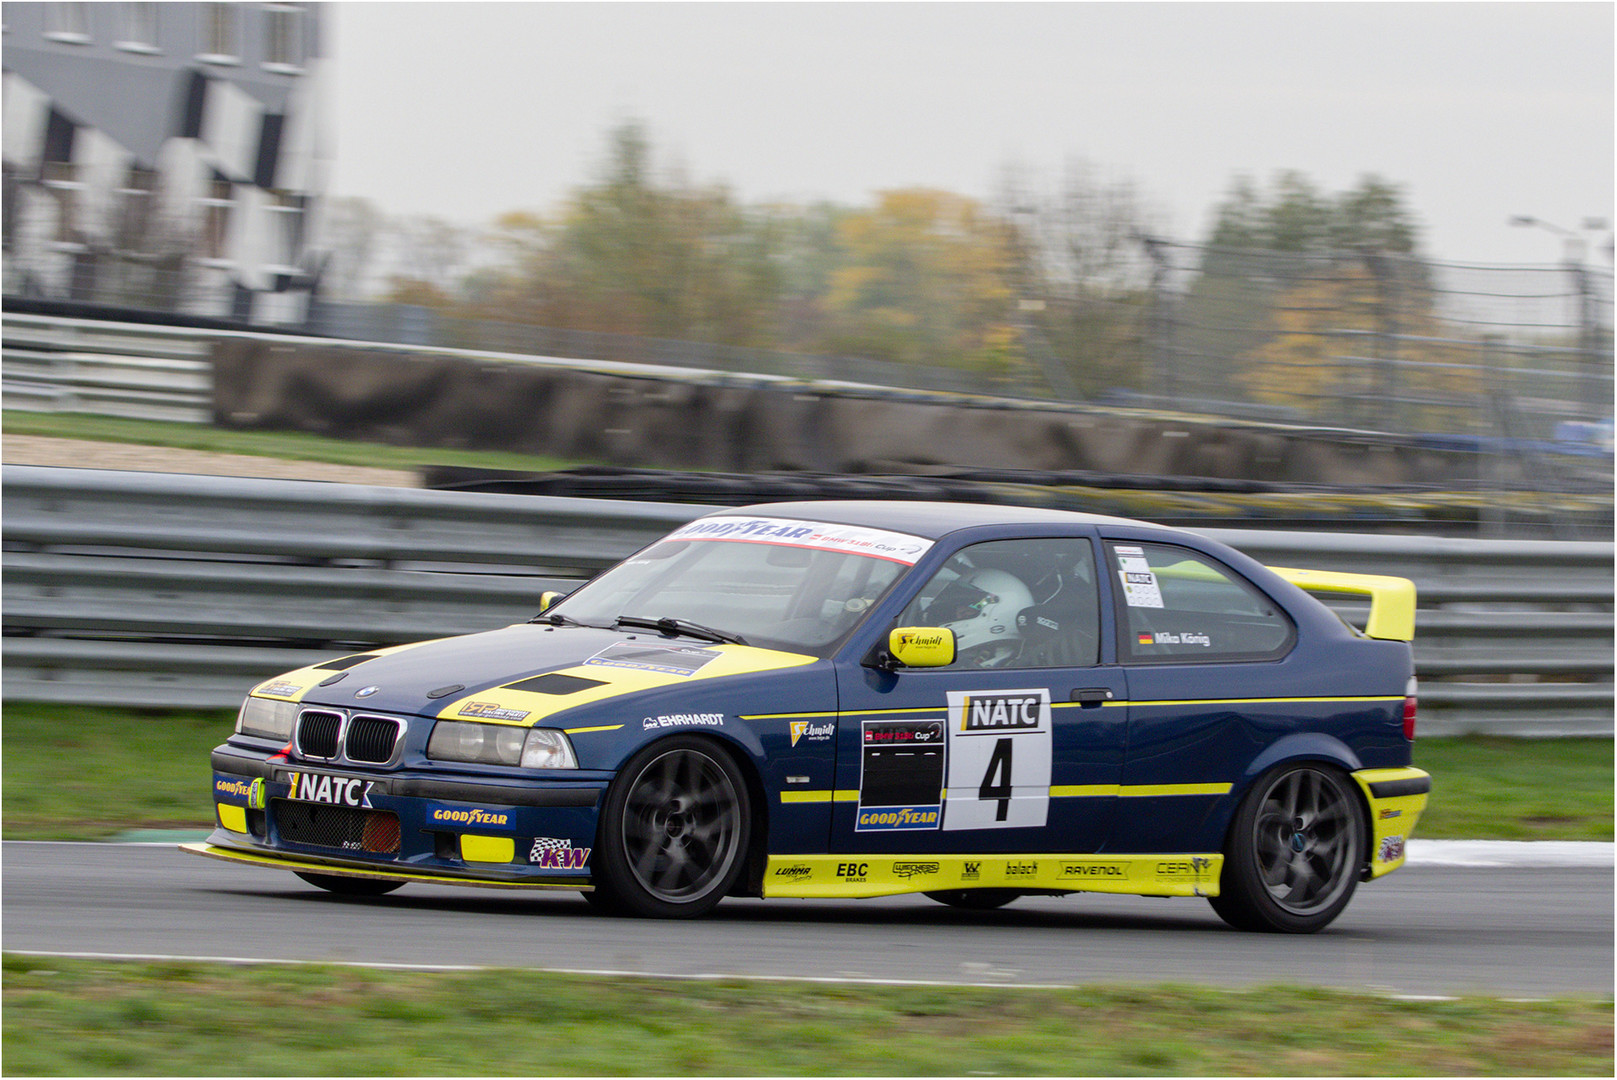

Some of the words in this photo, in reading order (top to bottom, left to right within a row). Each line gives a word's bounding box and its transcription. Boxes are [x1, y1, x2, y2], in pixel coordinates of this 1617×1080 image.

[821, 536, 848, 544] BMW
[590, 659, 690, 675] GOODYEAR
[657, 713, 724, 727] EHRHARDT
[972, 698, 1036, 726] NATC
[792, 723, 835, 736] Schmidt
[874, 732, 894, 740] BMW
[915, 732, 930, 741] Cup
[978, 738, 1013, 821] 4
[216, 780, 251, 796] GOODYEA
[300, 773, 362, 806] NATC
[433, 809, 508, 825] GOODYEAR
[860, 808, 938, 827] GOODYEAR
[539, 847, 592, 869] KW
[775, 867, 811, 875] LUMMA
[836, 863, 868, 877] EBC
[1064, 866, 1122, 875] RAVENOL
